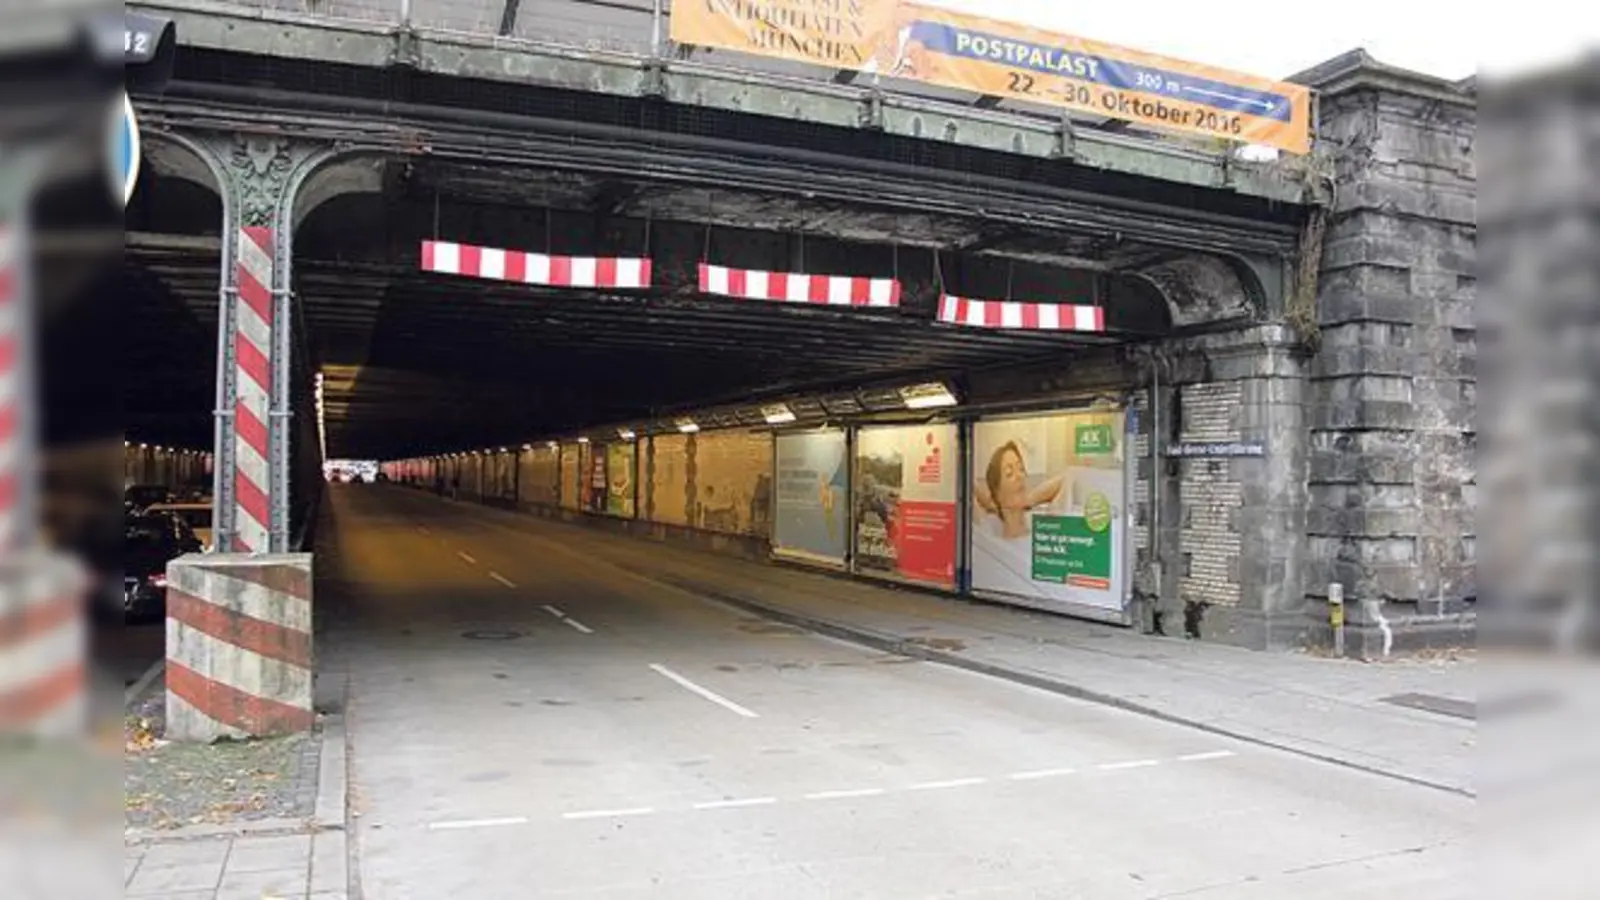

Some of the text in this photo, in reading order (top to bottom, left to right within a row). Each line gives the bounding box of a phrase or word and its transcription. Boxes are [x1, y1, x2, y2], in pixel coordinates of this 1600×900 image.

[955, 32, 1099, 78] POSTPALAST
[1007, 71, 1041, 96] 22.
[1063, 82, 1096, 107] 30.
[1101, 90, 1191, 125] Oktober
[1194, 106, 1242, 135] 2016
[1135, 71, 1180, 93] 300 m
